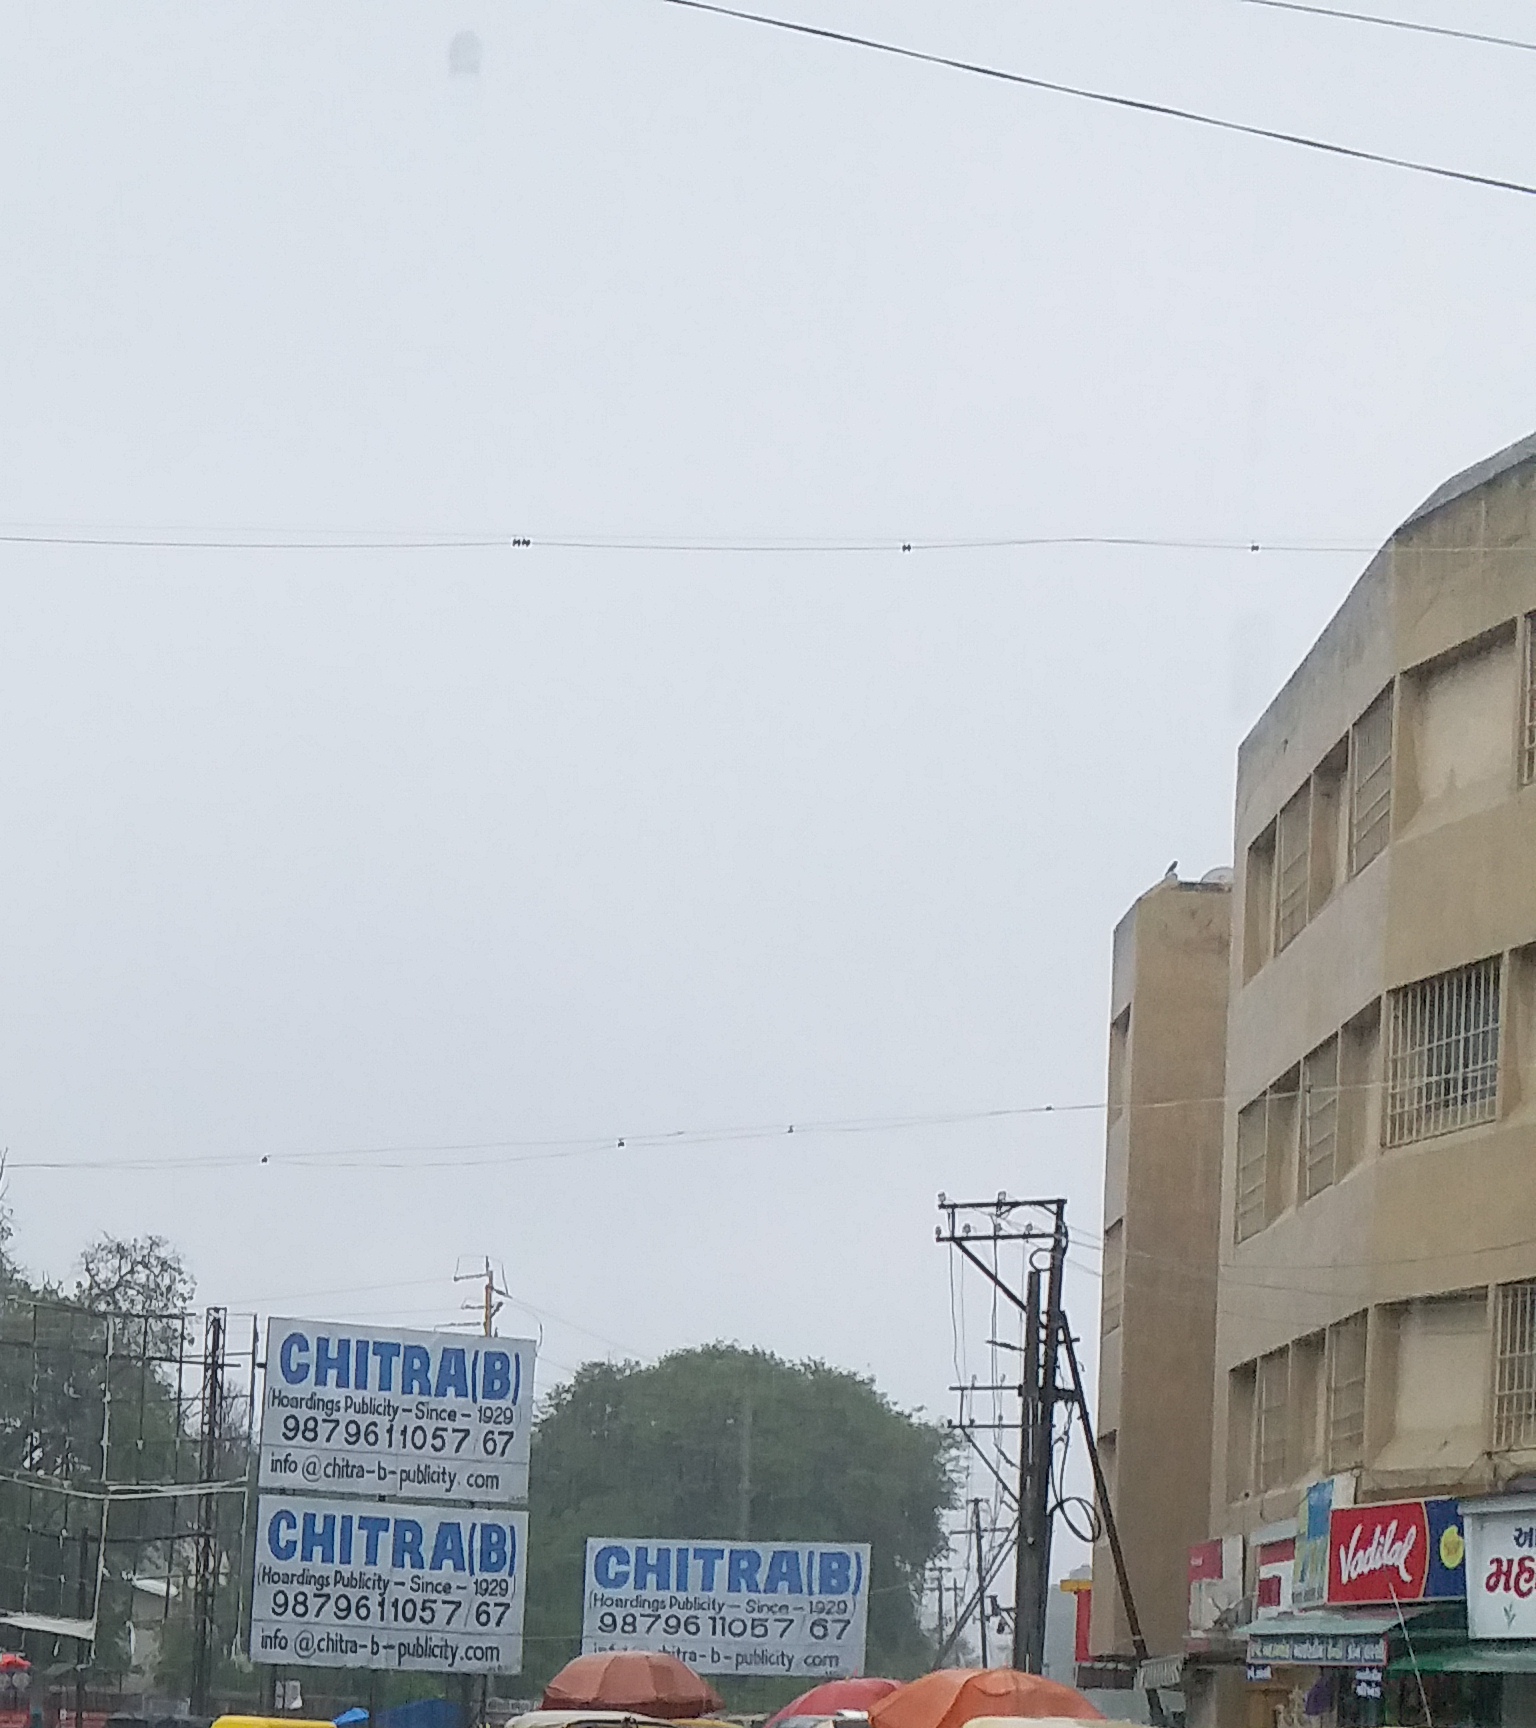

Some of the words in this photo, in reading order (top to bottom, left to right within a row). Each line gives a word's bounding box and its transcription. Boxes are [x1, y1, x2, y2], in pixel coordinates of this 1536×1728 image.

[281, 1332, 520, 1405] CHITRA(B)
[344, 1391, 399, 1419] Publicity
[415, 1402, 457, 1422] Since
[268, 1509, 517, 1578] CHITRA(B)
[1340, 1519, 1417, 1584] Vadilal
[333, 1570, 390, 1595] Publicity
[409, 1574, 452, 1594] Since
[594, 1545, 863, 1596] CHITRA(B)
[1485, 1555, 1536, 1598] મહ
[669, 1594, 726, 1614] Publicity
[745, 1599, 789, 1615] Since
